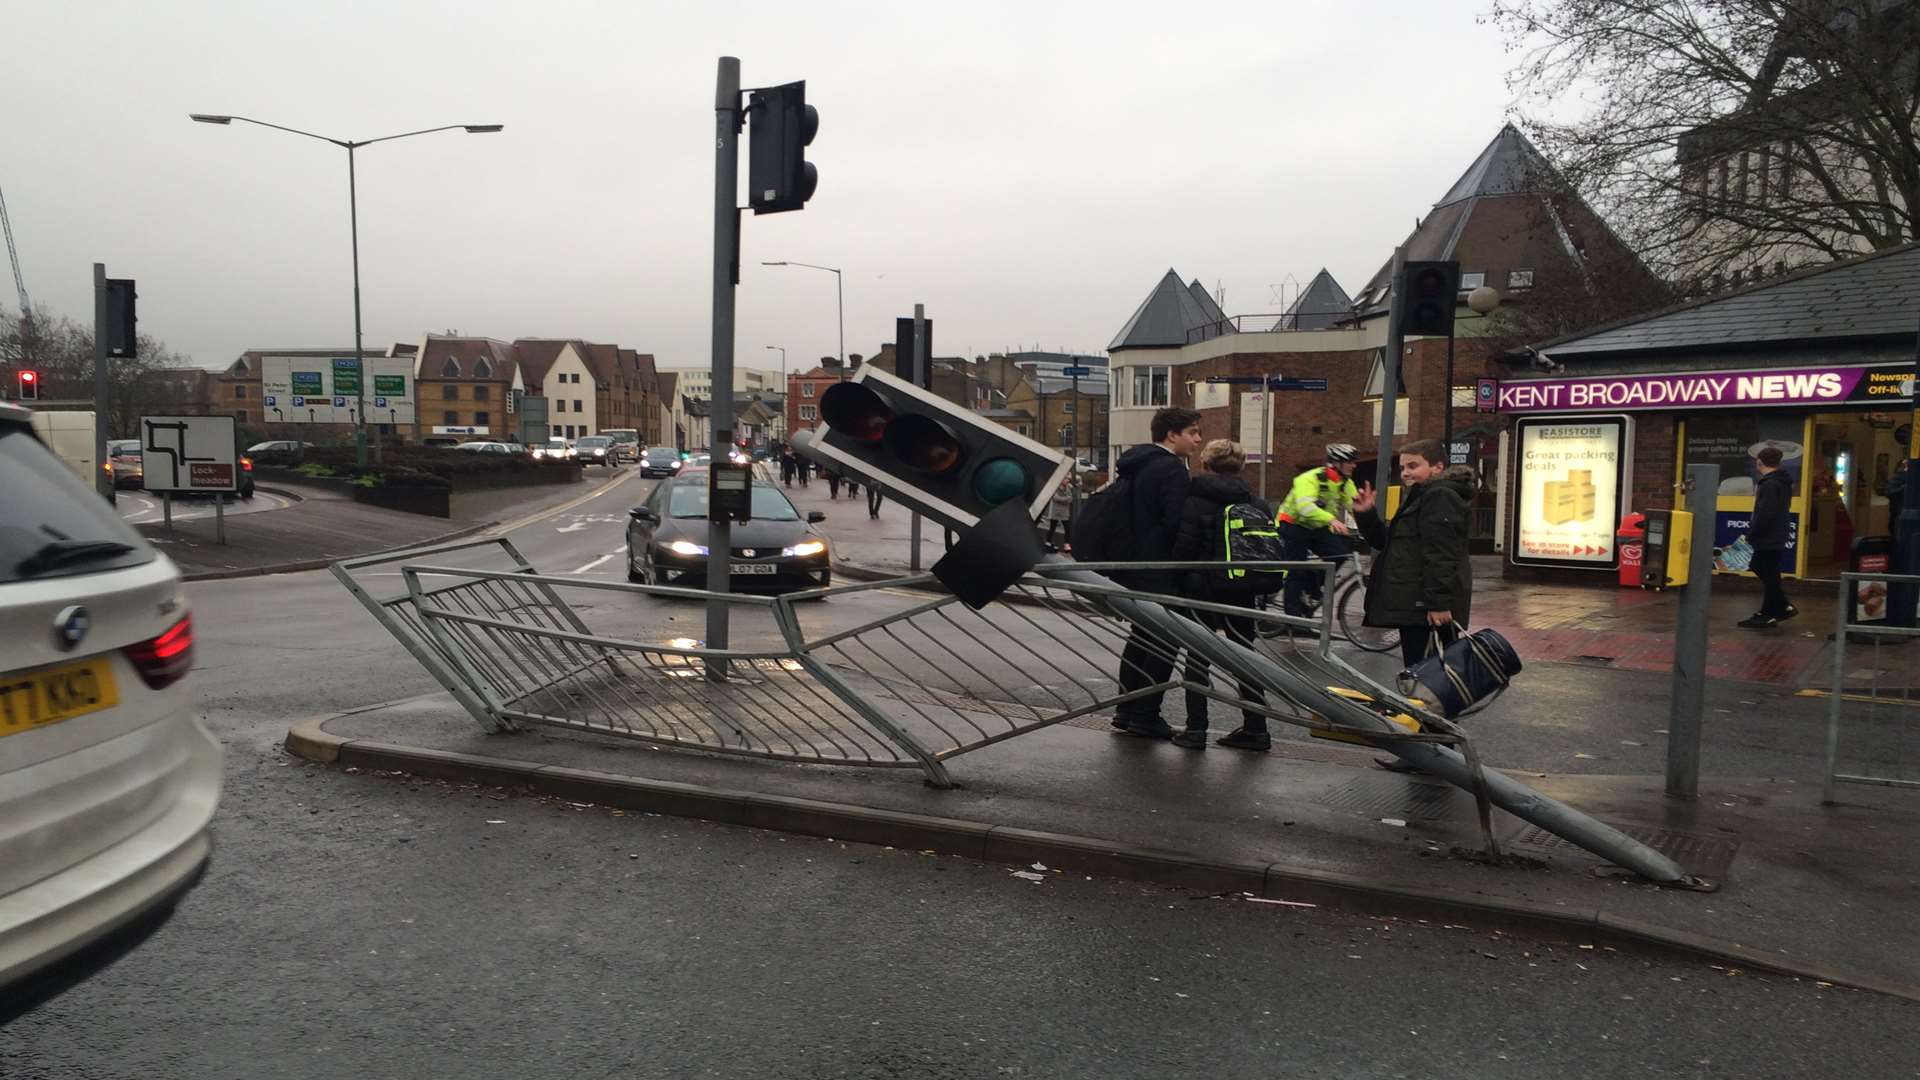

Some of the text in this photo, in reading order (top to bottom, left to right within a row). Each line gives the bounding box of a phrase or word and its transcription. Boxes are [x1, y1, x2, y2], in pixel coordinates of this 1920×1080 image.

[1499, 372, 1842, 408] KENT BROADWAY NEWS
[1868, 384, 1900, 394] Off-li
[1539, 427, 1602, 440] EASISTORE
[1525, 450, 1616, 462] Great packing
[1525, 462, 1557, 470] deals
[1727, 520, 1751, 529] PICK
